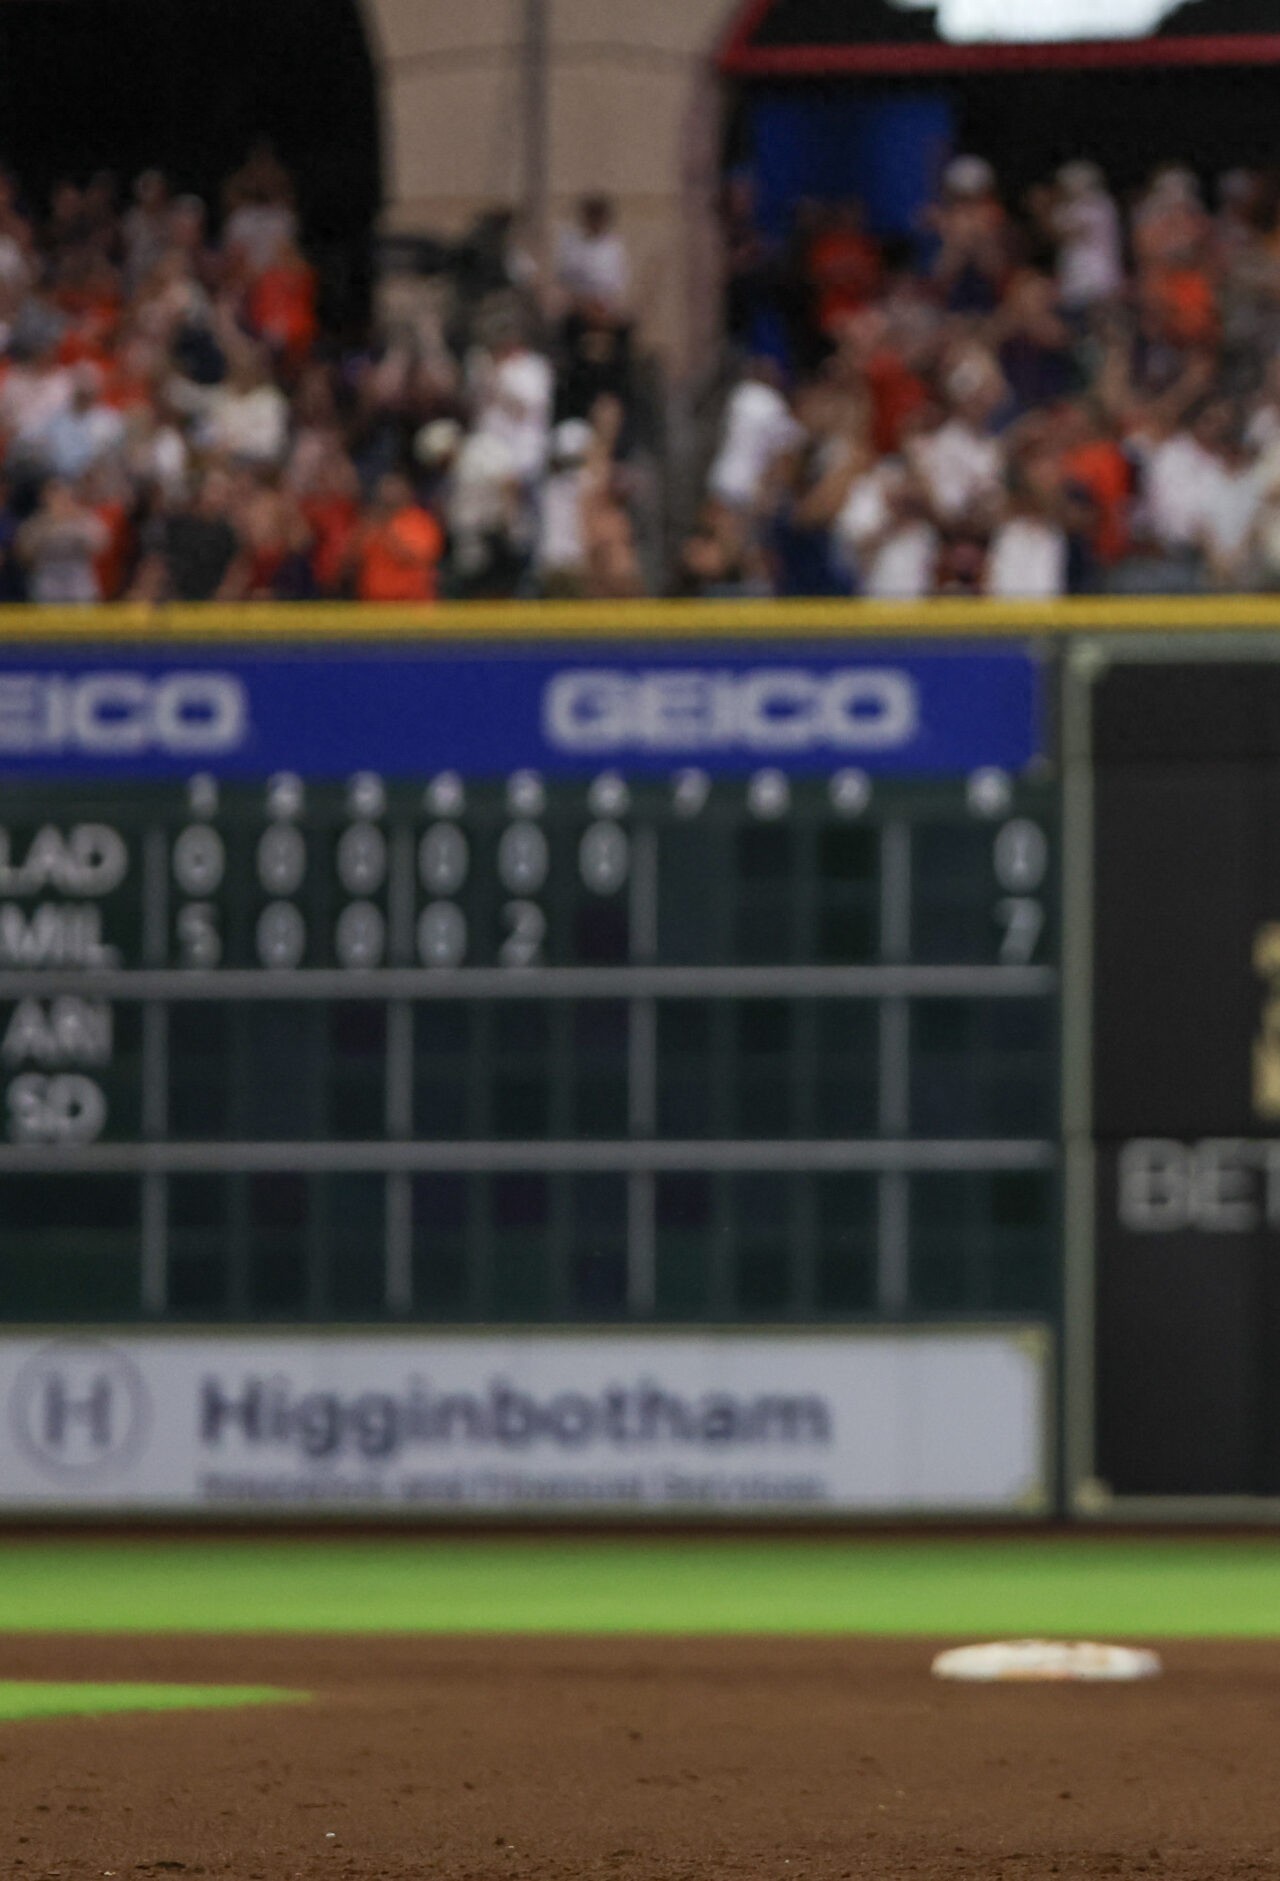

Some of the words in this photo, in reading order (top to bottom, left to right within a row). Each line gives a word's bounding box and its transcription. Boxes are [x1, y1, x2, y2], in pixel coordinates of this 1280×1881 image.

[542, 667, 919, 754] GEICO
[0, 822, 129, 896] LAD
[2, 998, 113, 1067] ARI
[5, 1073, 107, 1146] SD
[200, 1372, 833, 1460] Higginbotham
